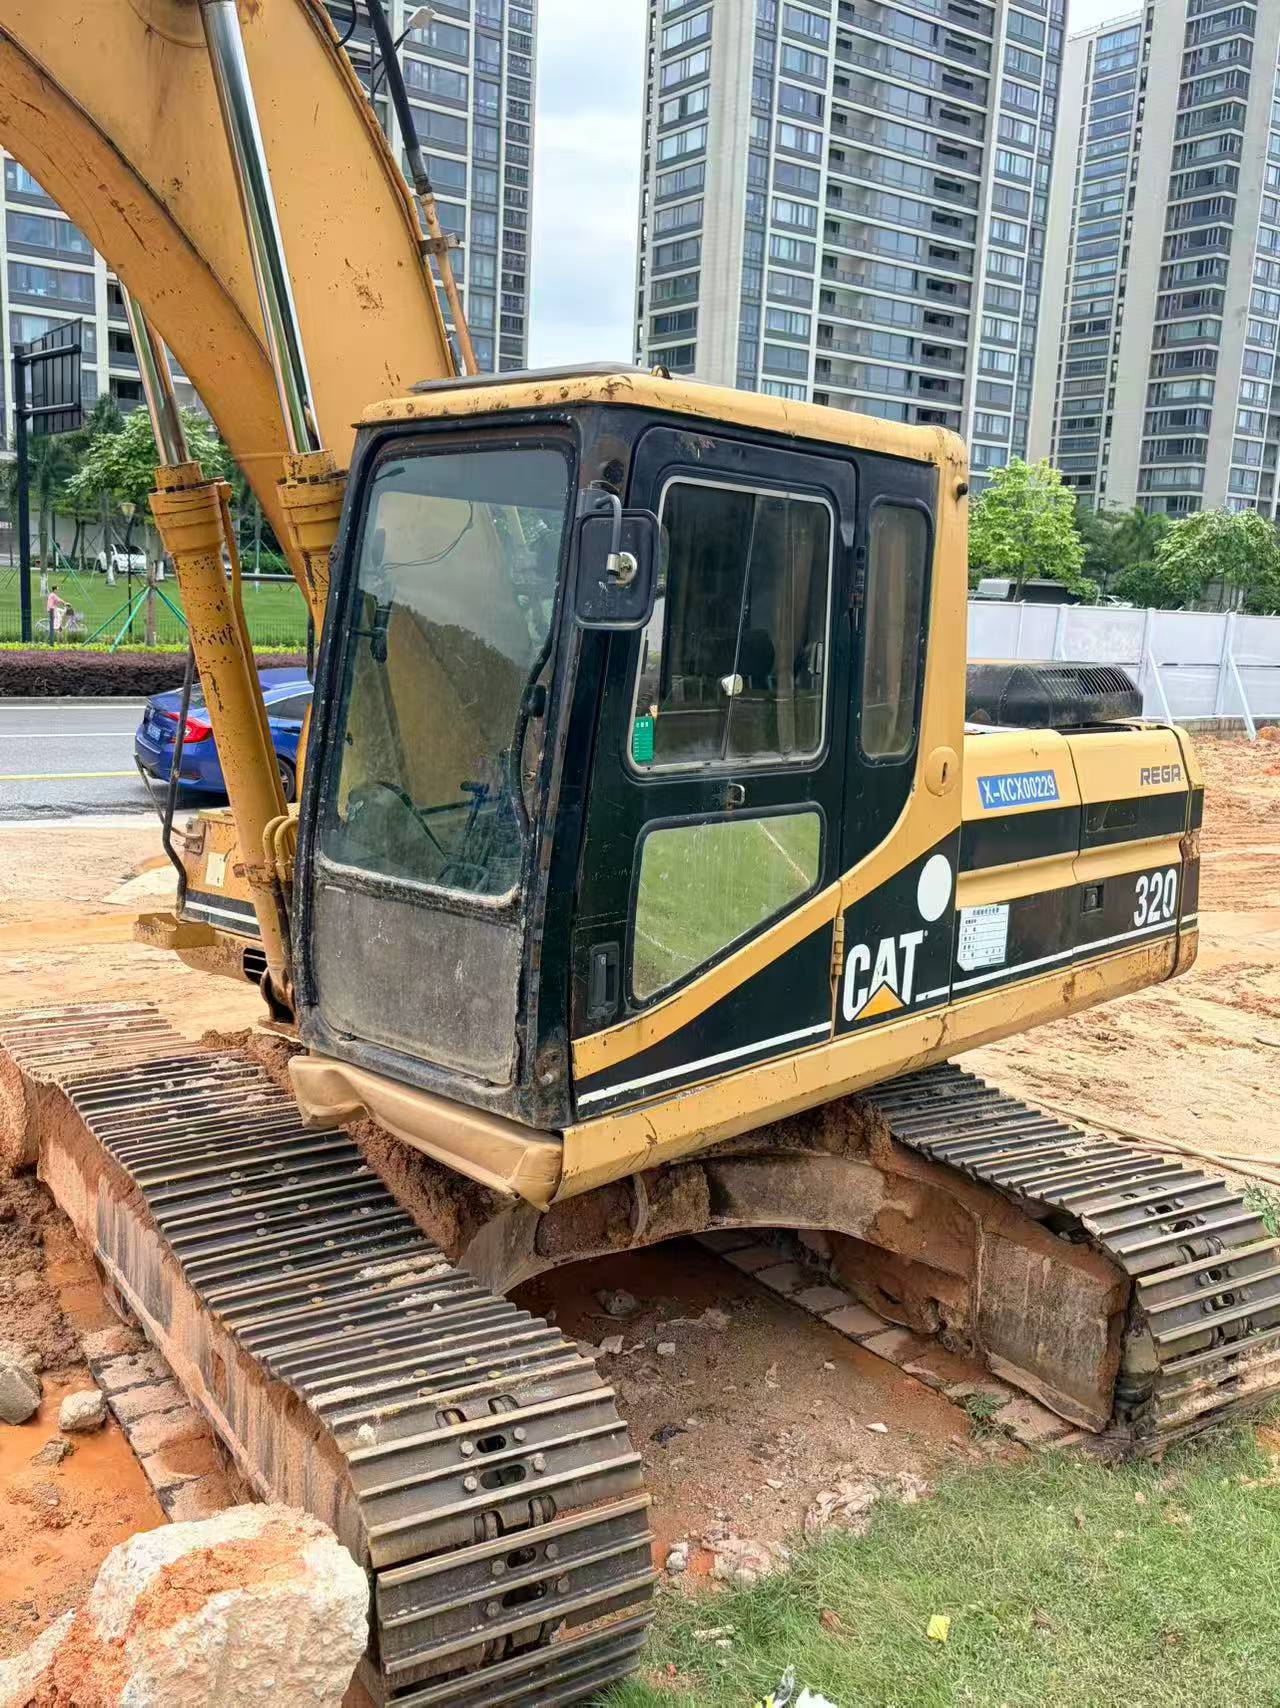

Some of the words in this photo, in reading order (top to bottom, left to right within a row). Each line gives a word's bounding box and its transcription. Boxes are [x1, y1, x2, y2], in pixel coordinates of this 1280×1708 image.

[982, 774, 1056, 804] X-KCX00229
[1140, 764, 1182, 786] REGA
[1133, 868, 1177, 927] 320
[842, 929, 924, 1022] CAT
